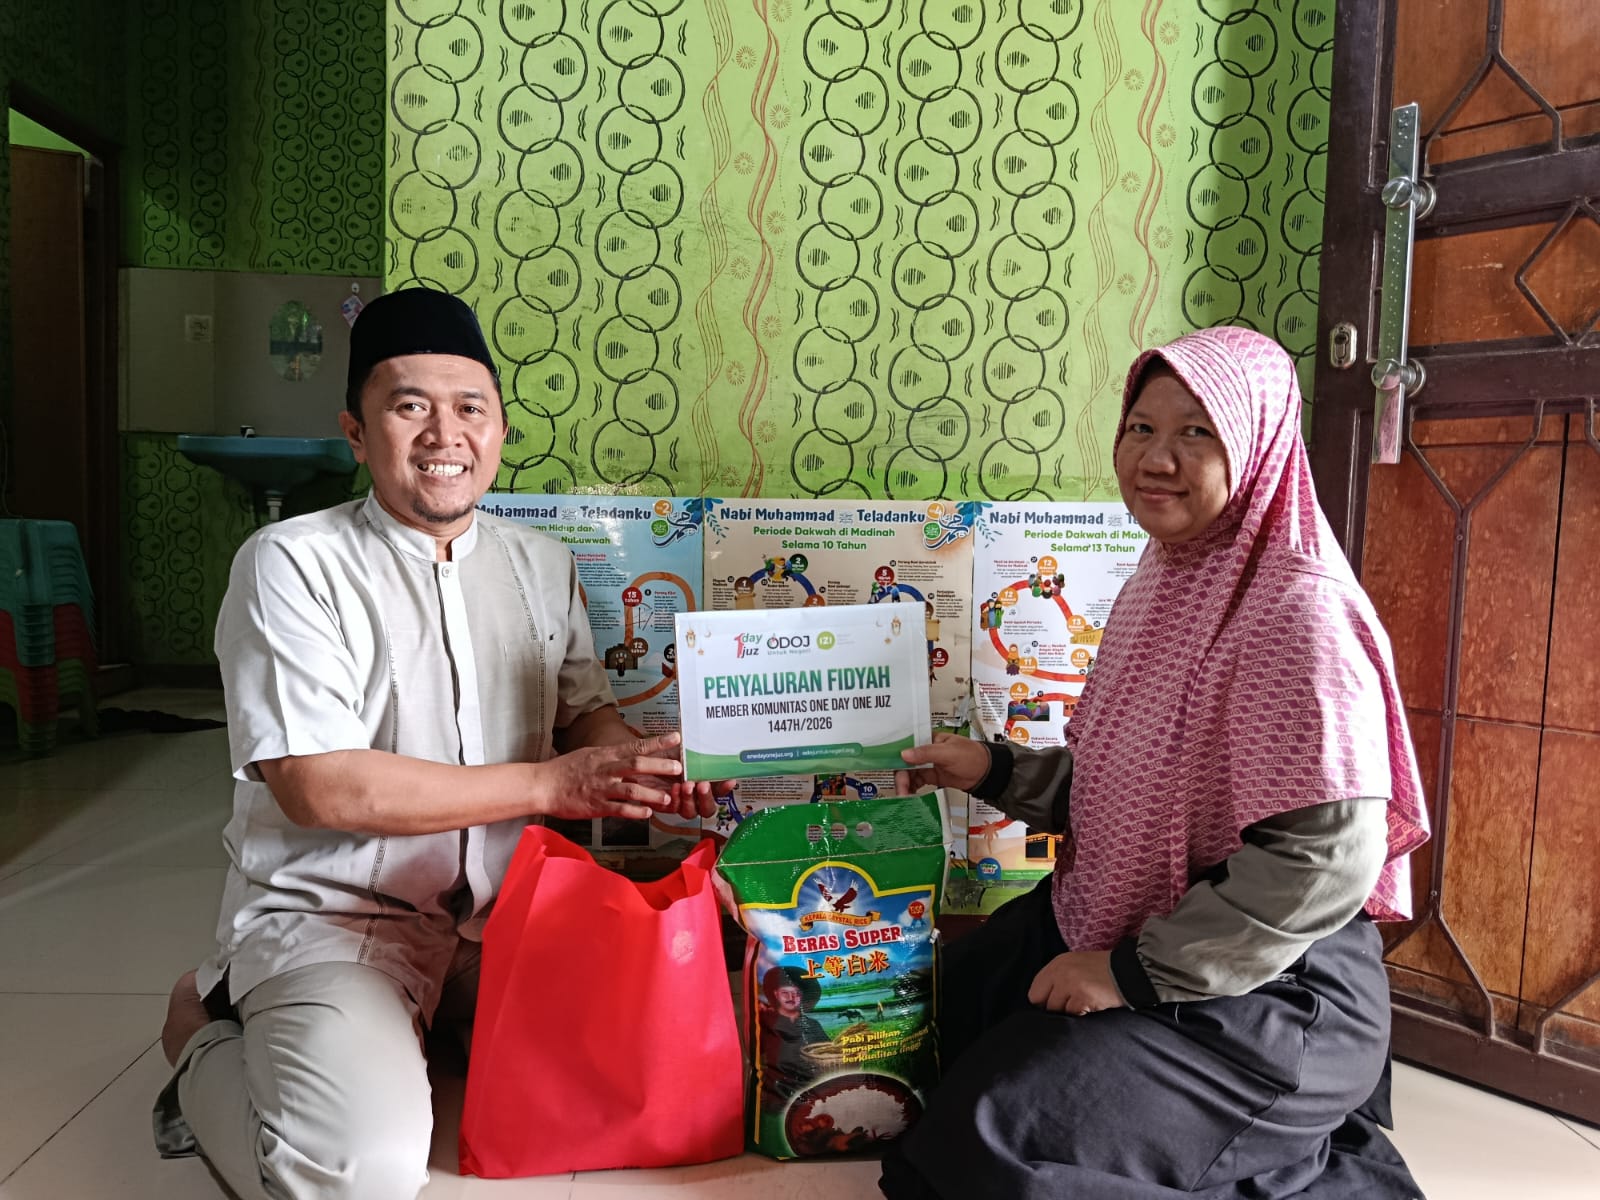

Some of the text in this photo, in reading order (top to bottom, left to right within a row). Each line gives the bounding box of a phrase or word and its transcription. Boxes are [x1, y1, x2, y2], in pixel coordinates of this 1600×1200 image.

[580, 506, 651, 520] Teladanku
[720, 507, 752, 521] Nabi
[755, 508, 835, 522] Muhammad
[856, 509, 925, 523] Teladanku
[989, 511, 1021, 525] Nabi
[1024, 512, 1104, 526] Muhammad
[548, 524, 574, 535] Hidup
[753, 526, 895, 538] Periode Dakwah di Madinah
[1024, 530, 1062, 540] Periode
[1065, 530, 1107, 540] Dakwah
[1110, 530, 1120, 540] di
[781, 540, 867, 550] Selama 10 Tahun
[1050, 543, 1136, 553] Selama 13 Tahun
[881, 569, 888, 577] 5
[742, 632, 763, 645] day
[766, 636, 810, 649] ODOJ
[741, 647, 759, 659] juz
[936, 650, 942, 658] 6
[703, 669, 822, 699] PENYALURAN
[827, 665, 891, 691] FIDYAH
[705, 694, 892, 719] MEMBER KOMUNITAS ONE DAY ONE JUZ
[767, 716, 833, 733] 1447H/2026
[862, 785, 873, 793] 10
[782, 926, 902, 952] BERAS SUPER
[800, 950, 889, 979] 上等白米
[841, 1030, 901, 1046] Padi pilihan
[842, 1041, 899, 1053] merupakan
